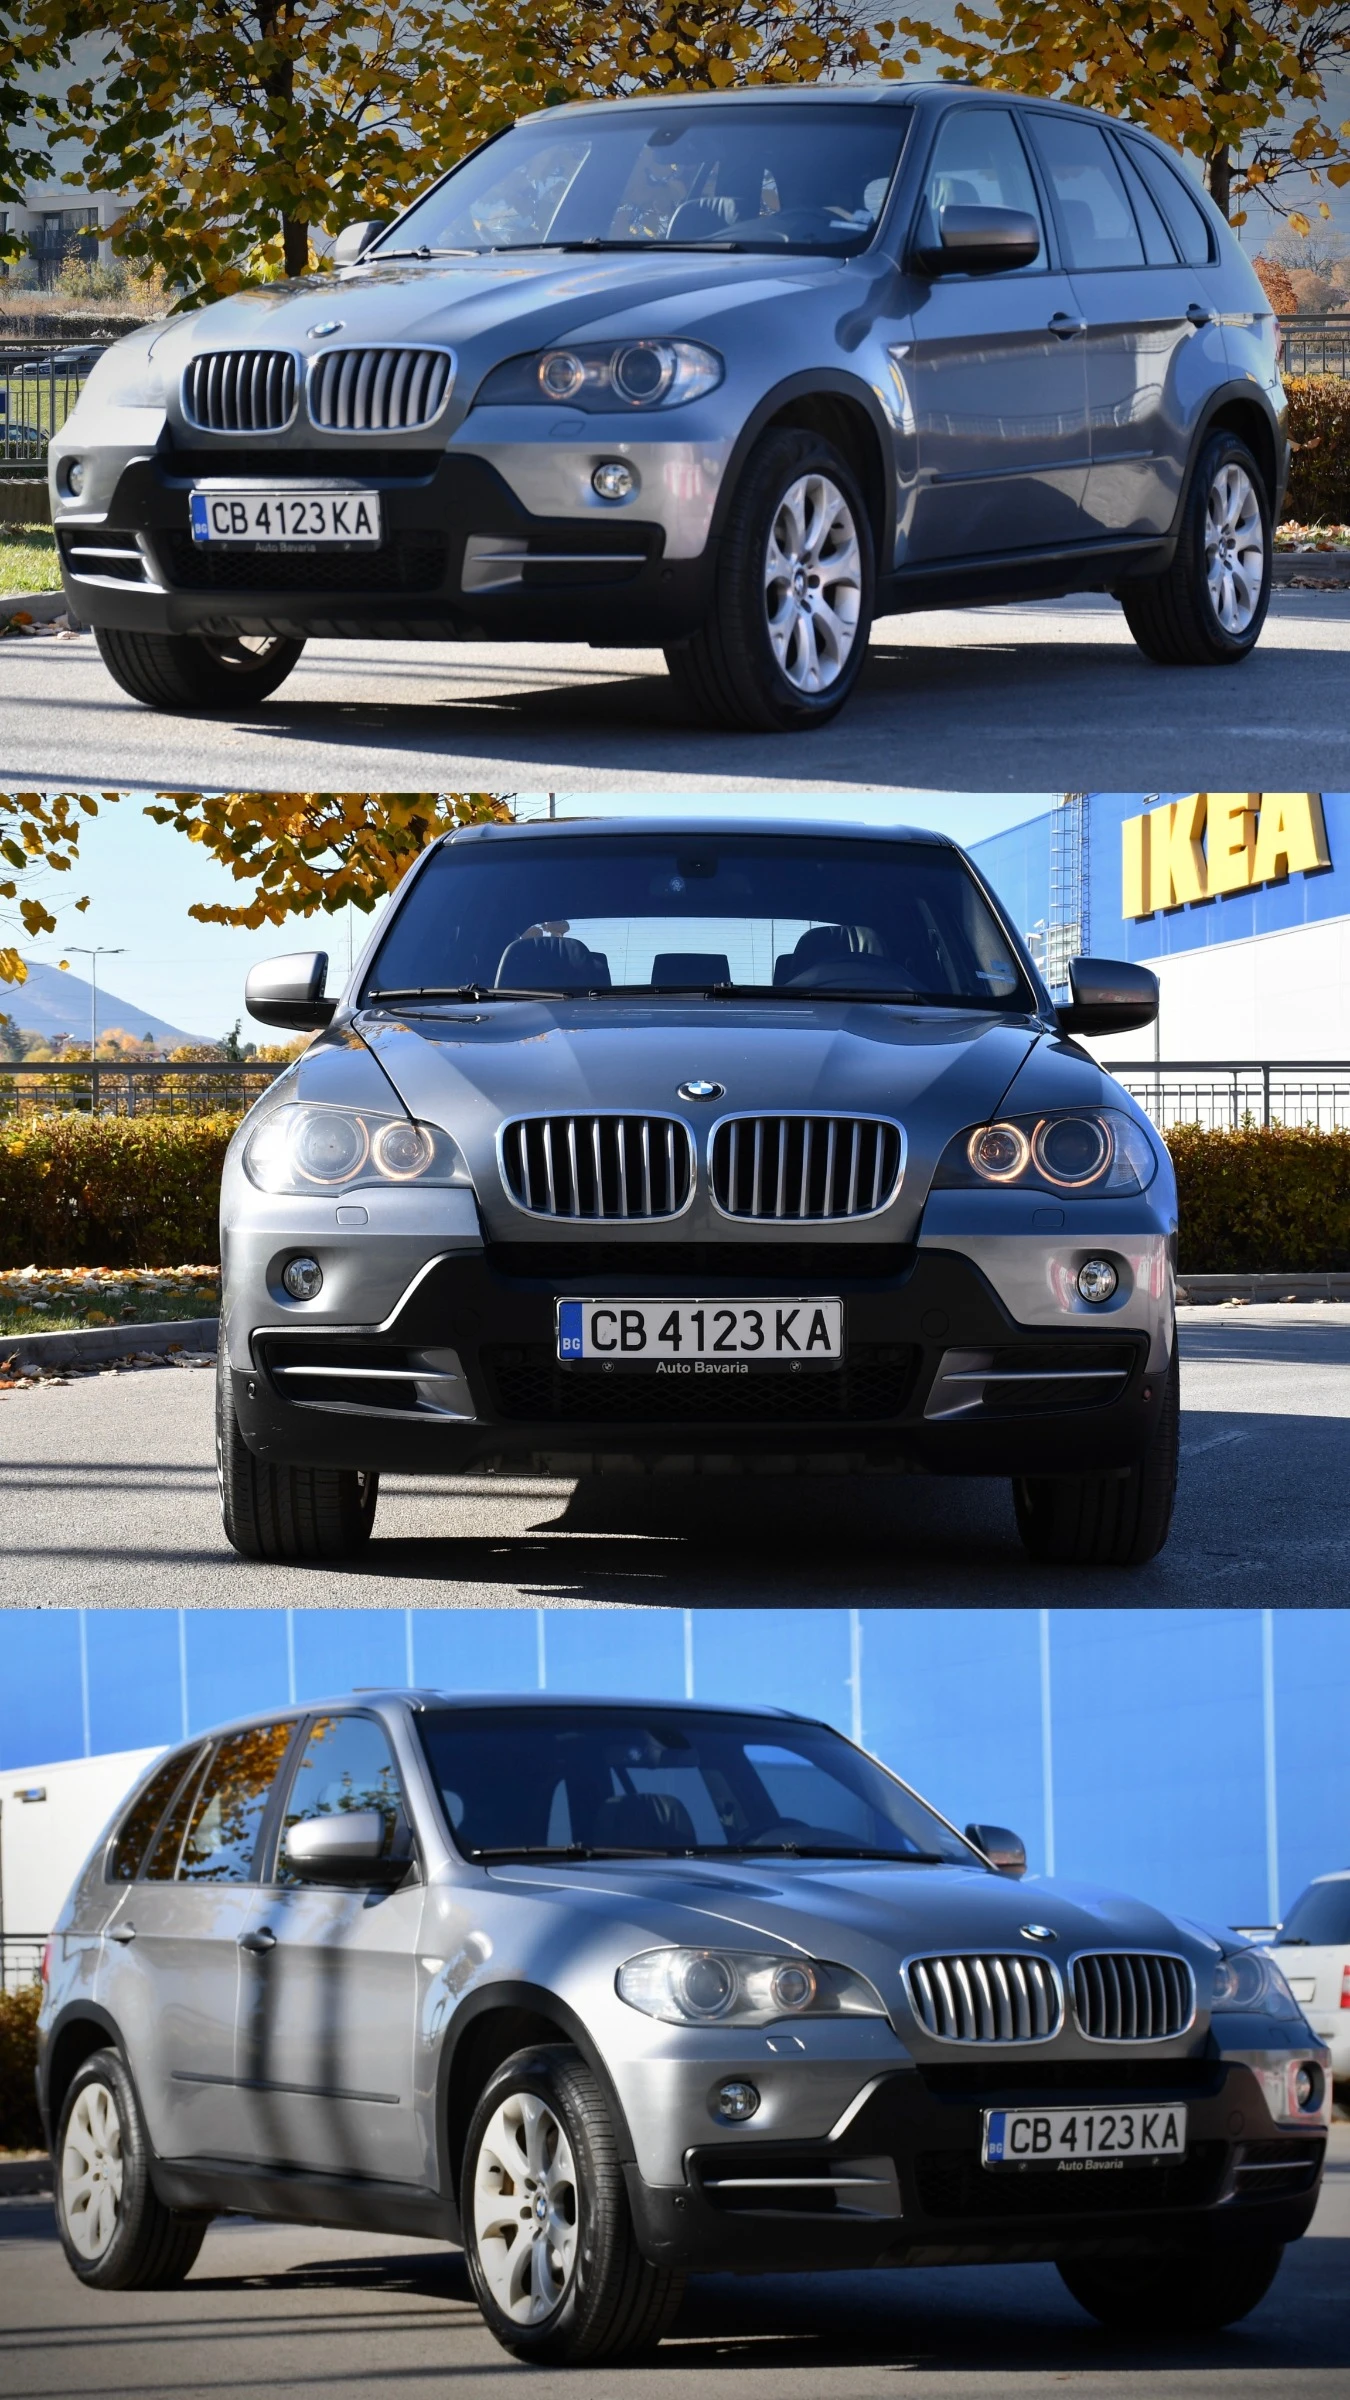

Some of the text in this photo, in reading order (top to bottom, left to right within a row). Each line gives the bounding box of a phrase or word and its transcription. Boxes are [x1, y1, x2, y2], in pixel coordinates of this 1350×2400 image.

[195, 523, 208, 534] BG
[255, 542, 317, 553] Auto Bavaria
[1122, 793, 1332, 920] IKEA
[562, 1337, 581, 1350] BG
[655, 1361, 749, 1374] Auto Bavaria
[989, 2143, 1003, 2154] BG
[1057, 2158, 1124, 2171] Auto Bavaria
